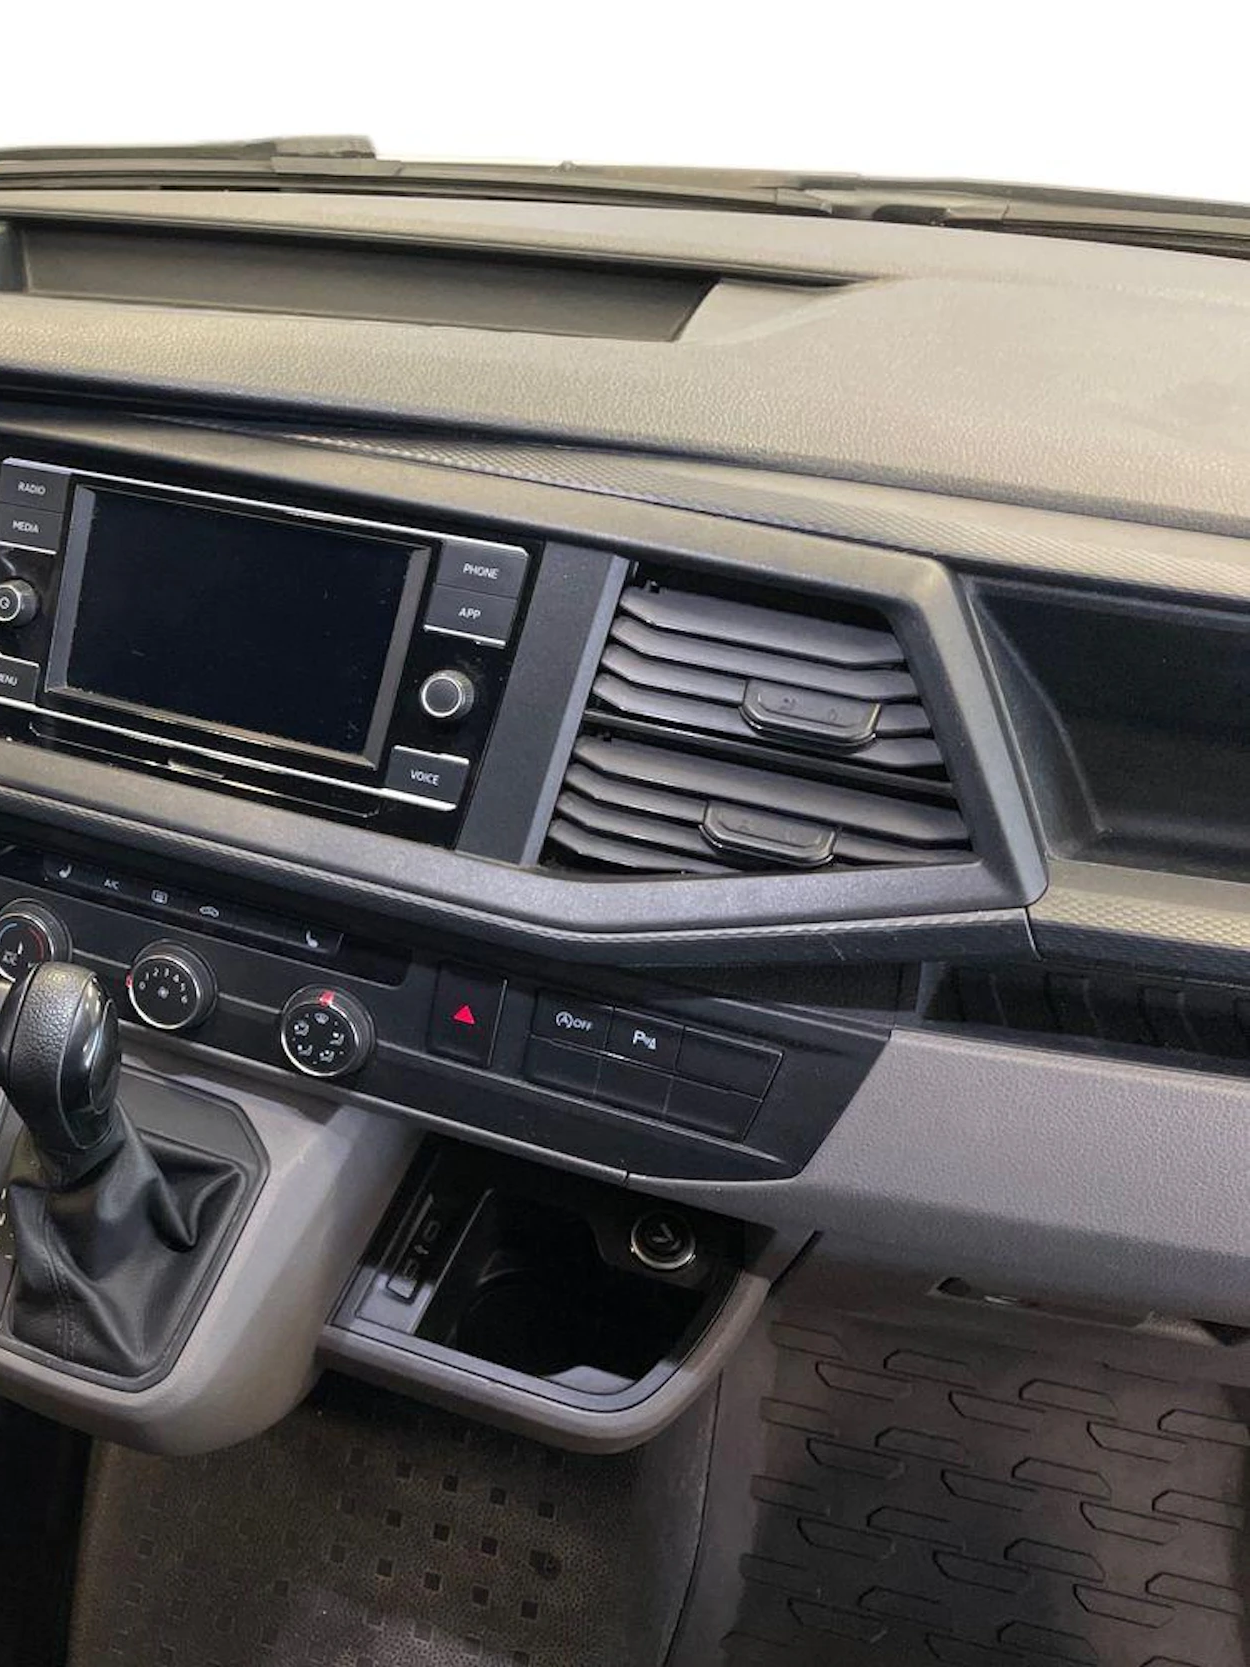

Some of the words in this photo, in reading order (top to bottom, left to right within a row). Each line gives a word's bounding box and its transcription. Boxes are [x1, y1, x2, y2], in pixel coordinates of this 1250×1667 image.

[17, 481, 46, 495] RADIO
[12, 520, 39, 533] MEDIA
[463, 563, 499, 579] PHONE
[458, 607, 481, 619] APP
[411, 769, 440, 787] VOICE
[152, 966, 160, 977] 2
[573, 1018, 592, 1031] OFF
